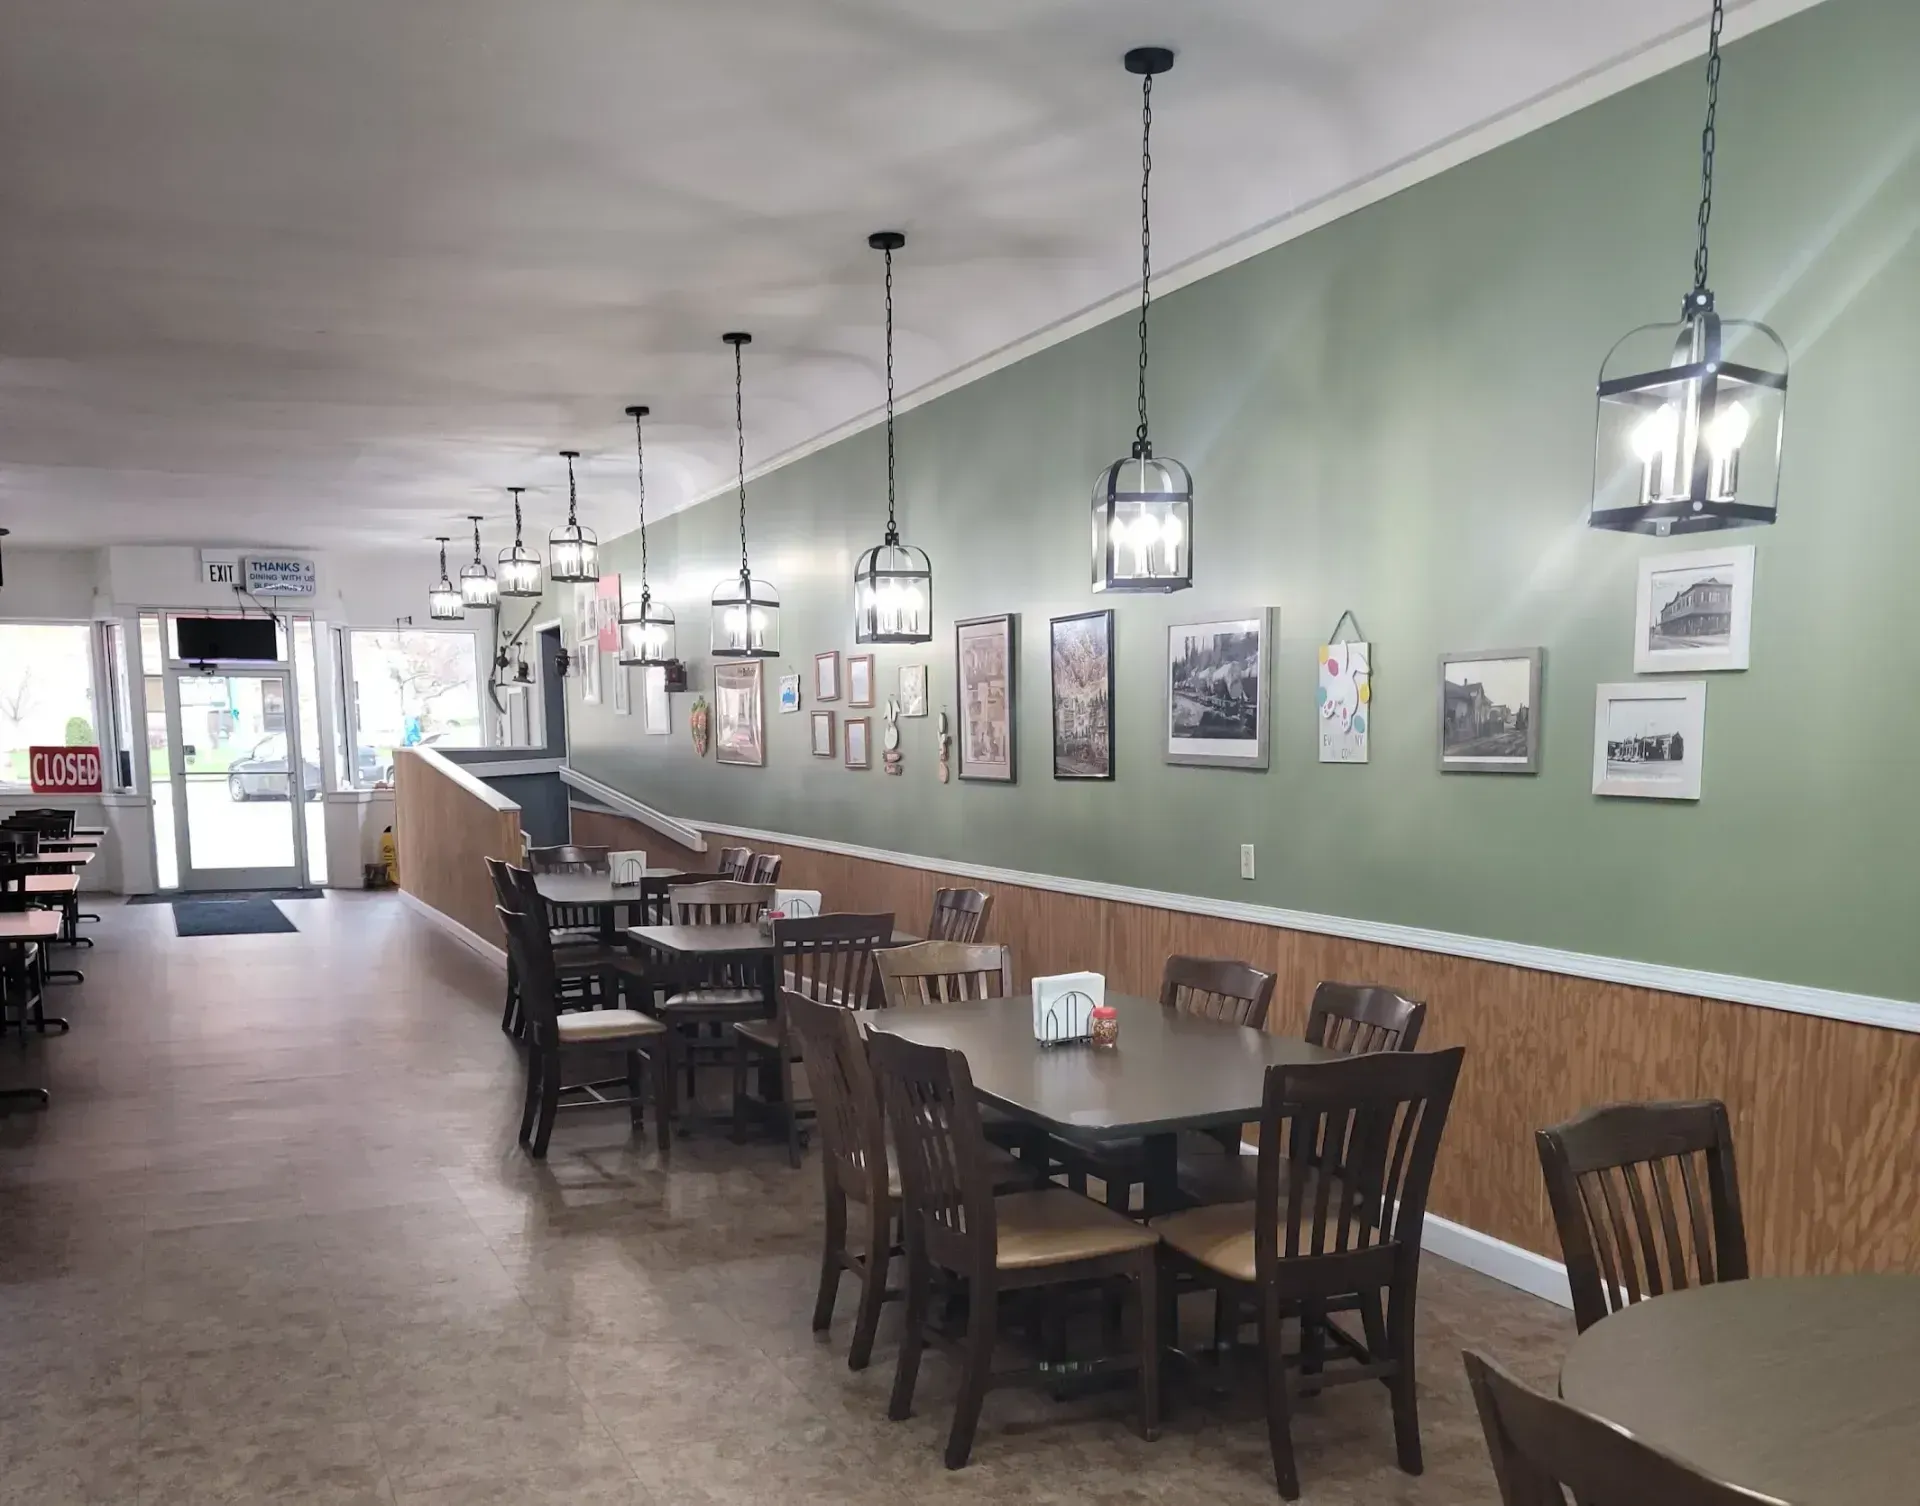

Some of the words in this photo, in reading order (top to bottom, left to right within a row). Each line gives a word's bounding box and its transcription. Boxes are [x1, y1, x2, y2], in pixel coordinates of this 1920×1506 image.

[209, 564, 234, 582] EXIT
[251, 561, 300, 572] THANKS
[249, 573, 278, 581] DINING
[280, 574, 302, 582] WITH
[33, 753, 98, 786] CLOSED
